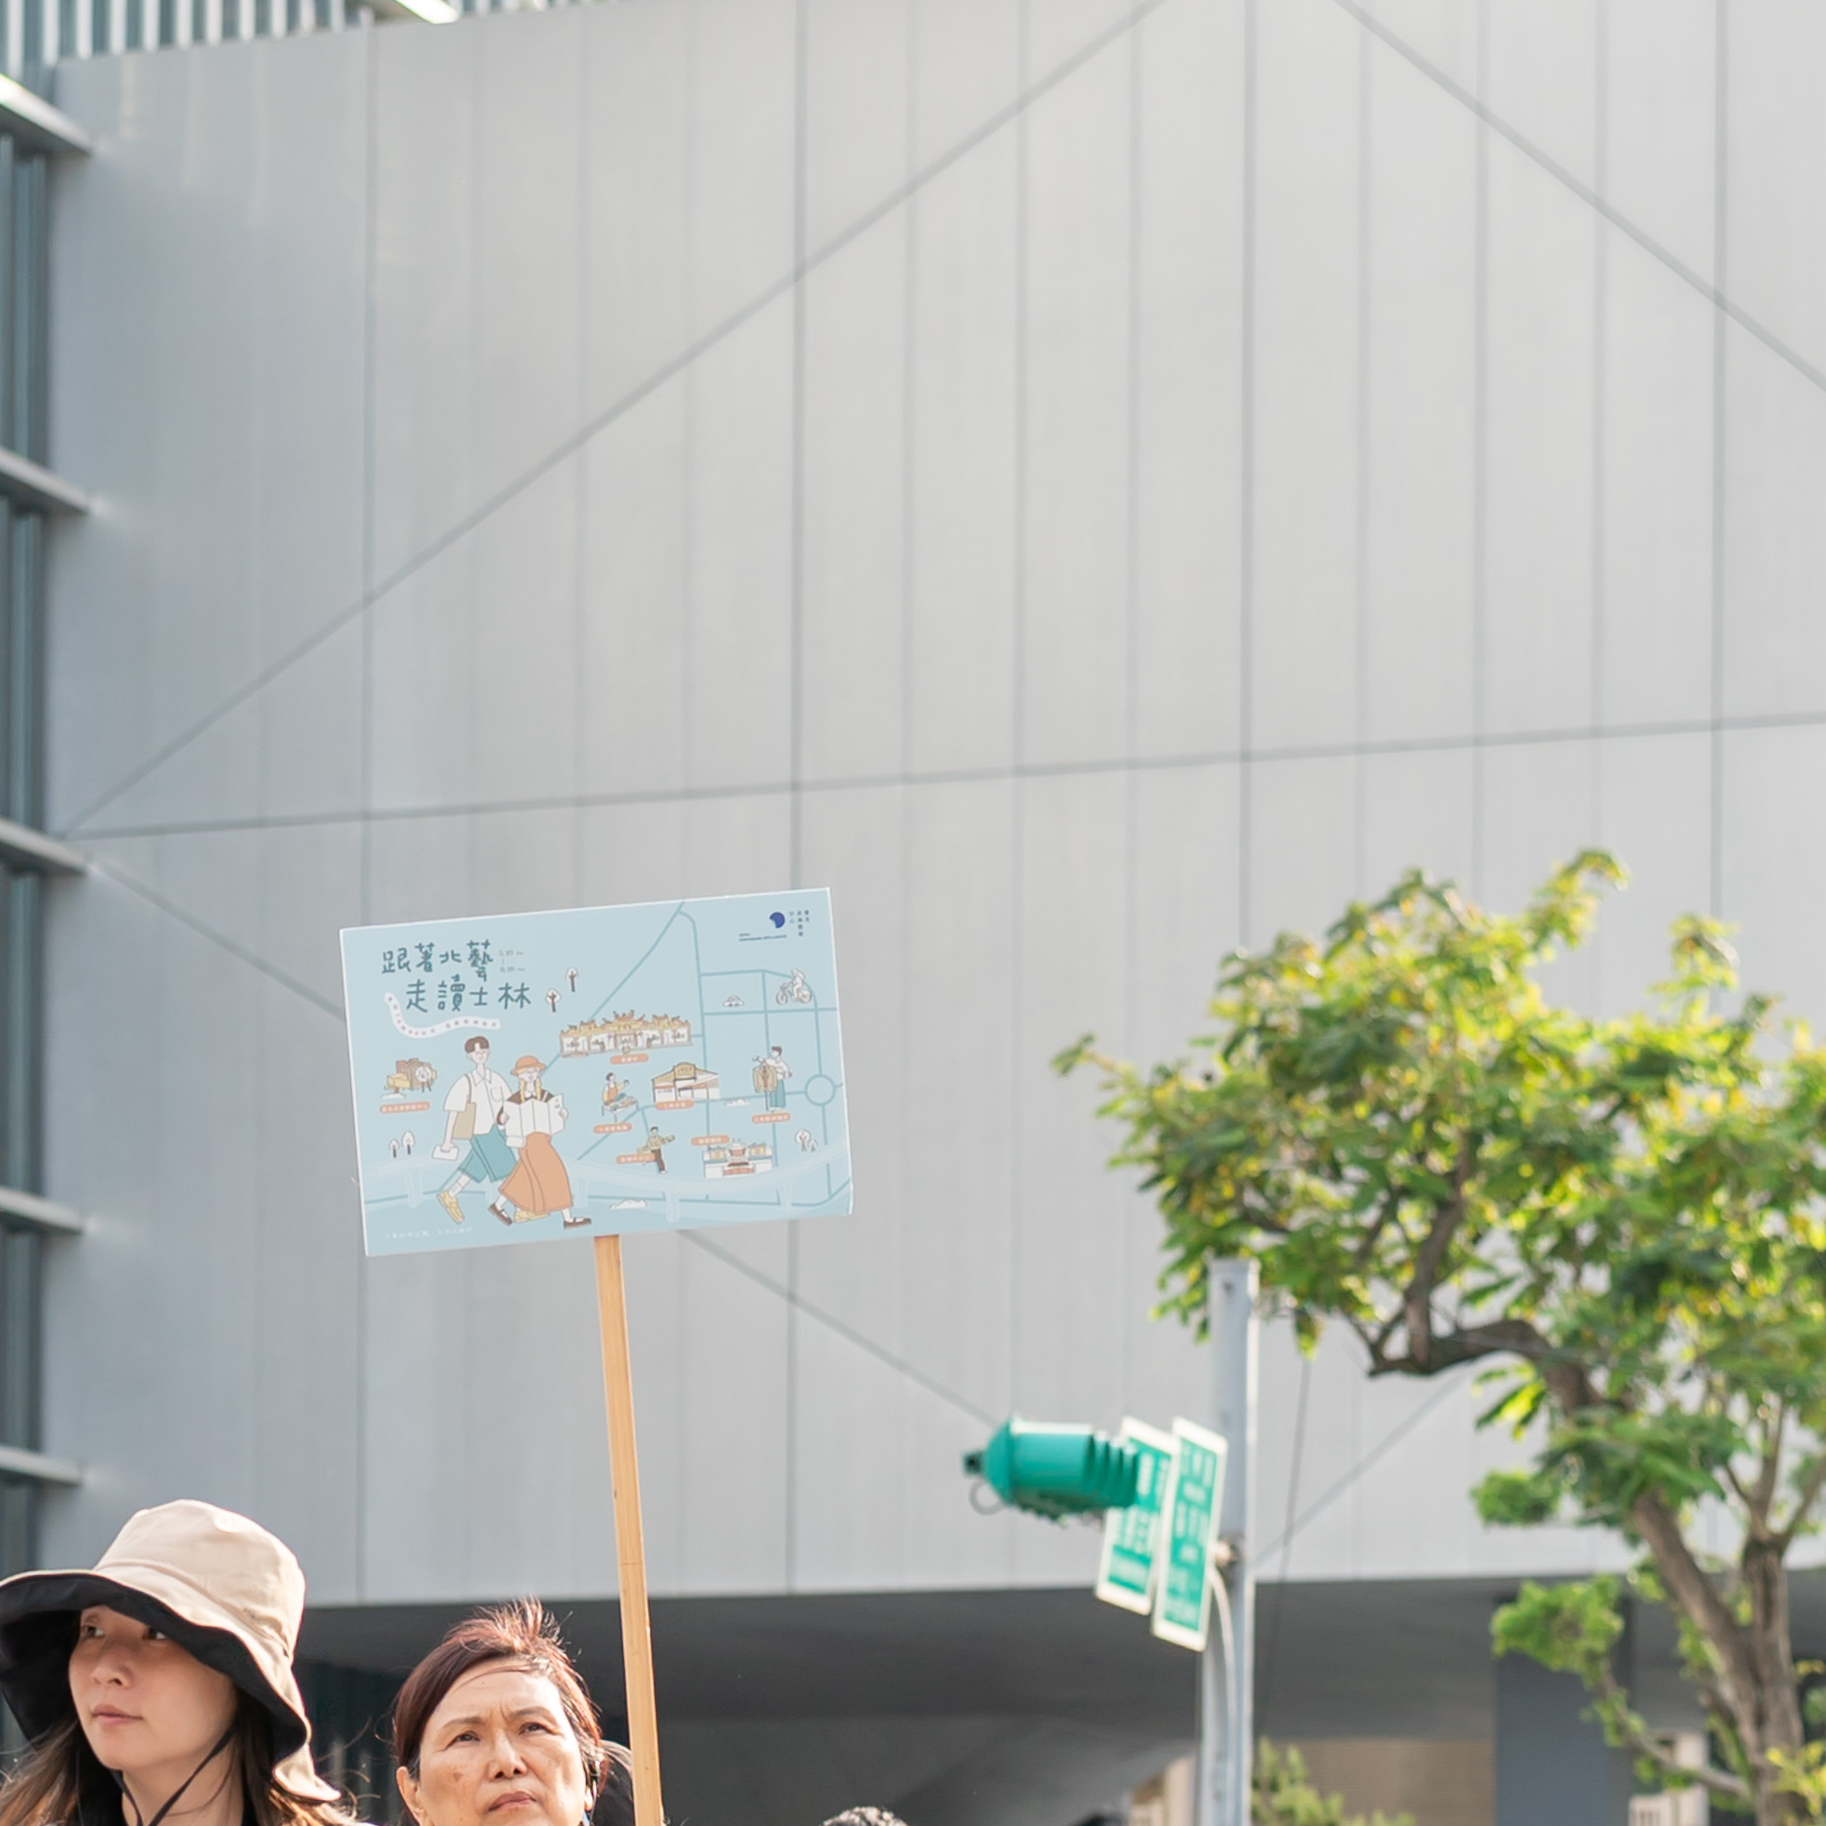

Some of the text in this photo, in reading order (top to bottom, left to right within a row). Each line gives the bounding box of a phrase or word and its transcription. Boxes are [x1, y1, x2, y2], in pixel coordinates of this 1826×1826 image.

[381, 939, 493, 982] 跟著北藝
[406, 974, 531, 1012] 走讀士林
